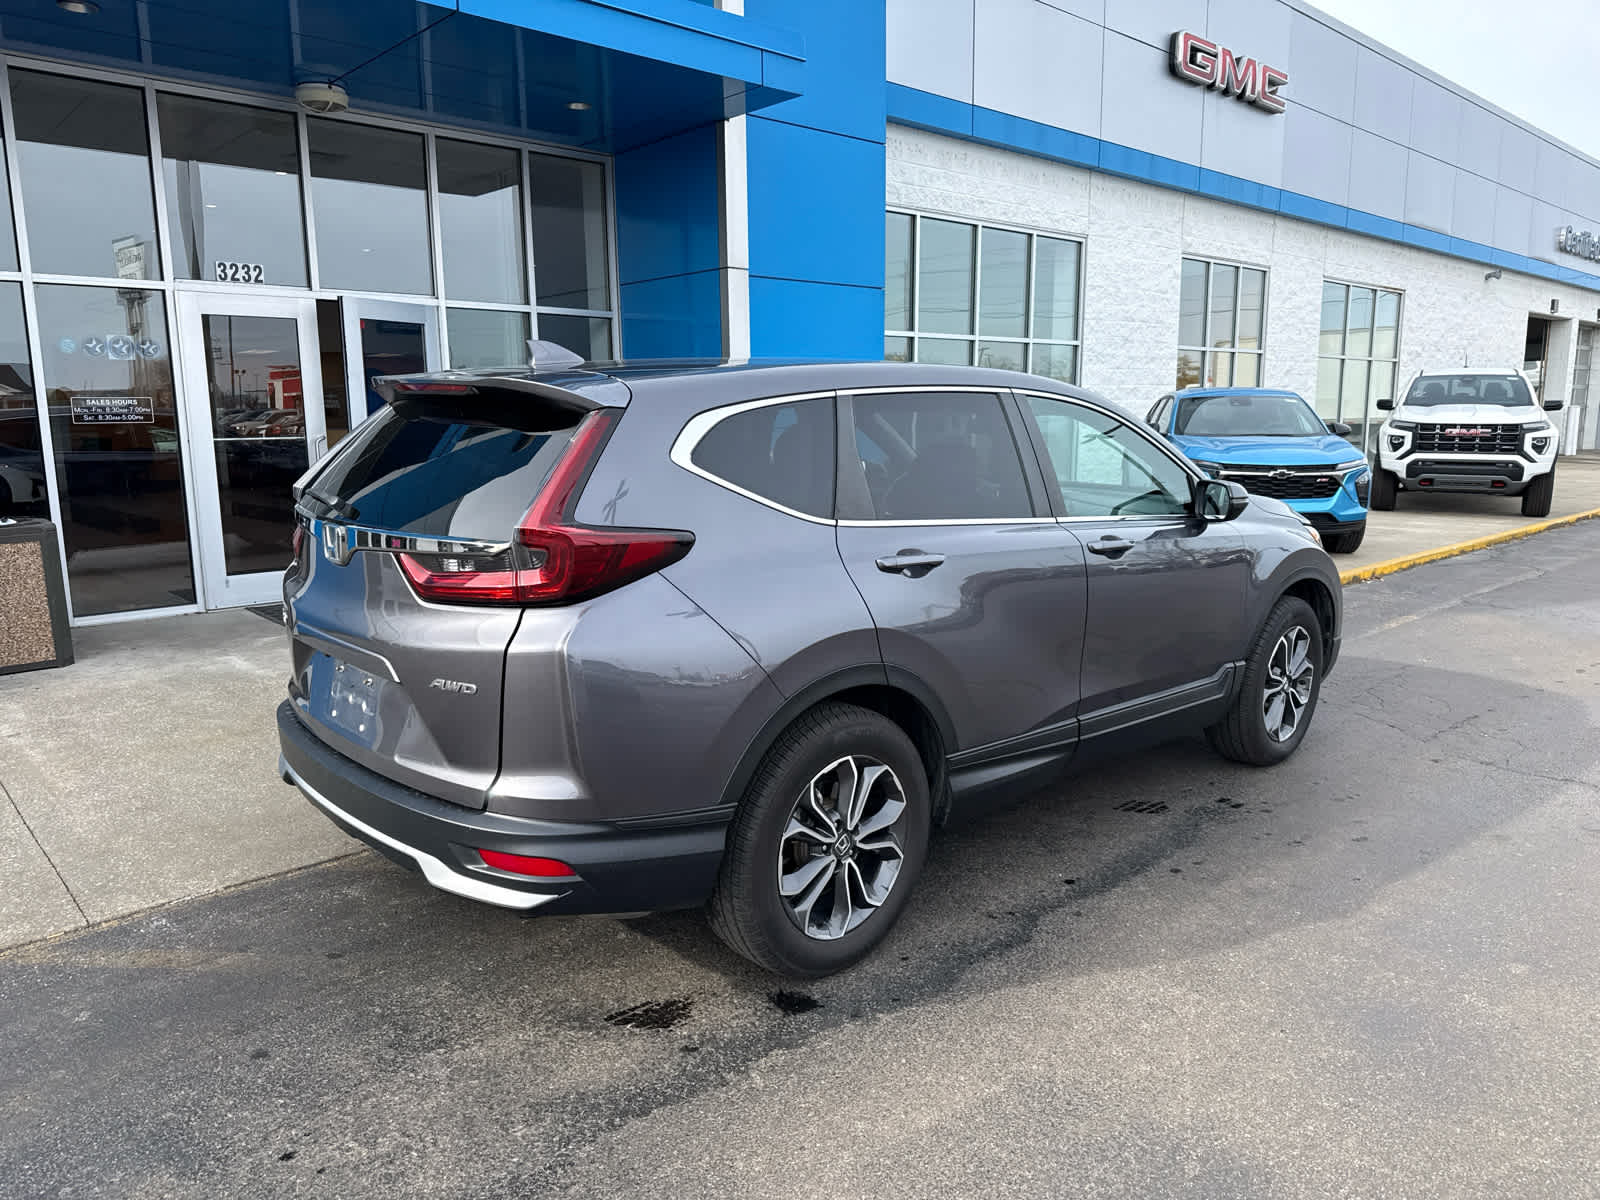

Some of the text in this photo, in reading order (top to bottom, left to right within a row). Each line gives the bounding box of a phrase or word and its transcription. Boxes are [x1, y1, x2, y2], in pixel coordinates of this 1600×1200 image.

[1169, 30, 1288, 114] GMC
[217, 262, 264, 284] 3232
[1445, 428, 1491, 437] GMC
[430, 678, 478, 694] AWD
